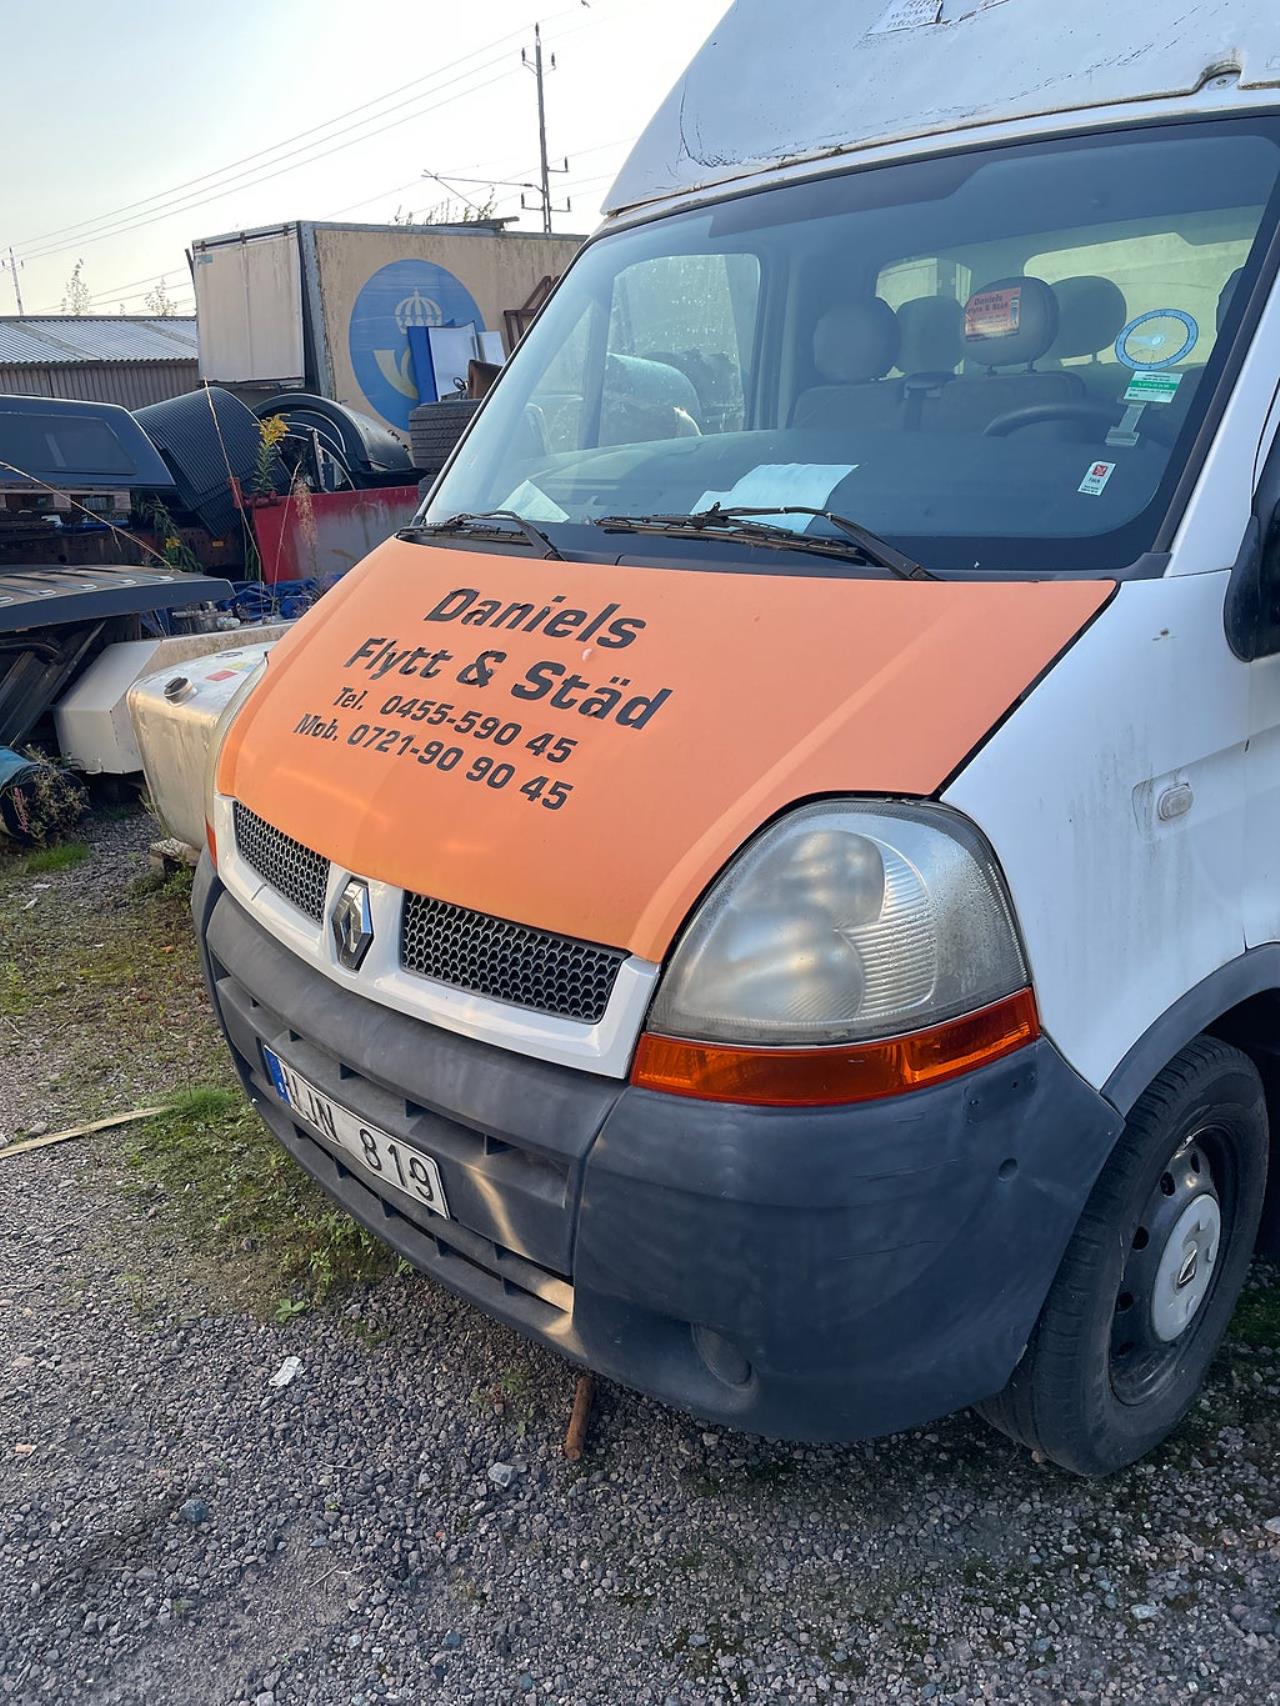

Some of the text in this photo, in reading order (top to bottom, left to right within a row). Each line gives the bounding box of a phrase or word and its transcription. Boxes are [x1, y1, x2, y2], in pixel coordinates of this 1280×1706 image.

[424, 588, 646, 648] Daniels
[344, 637, 673, 730] Flytt & Städ
[293, 713, 574, 810] Mob. 0721-90 90 45
[333, 686, 579, 763] Tel. 0455-590 45
[358, 1128, 435, 1203] 819
